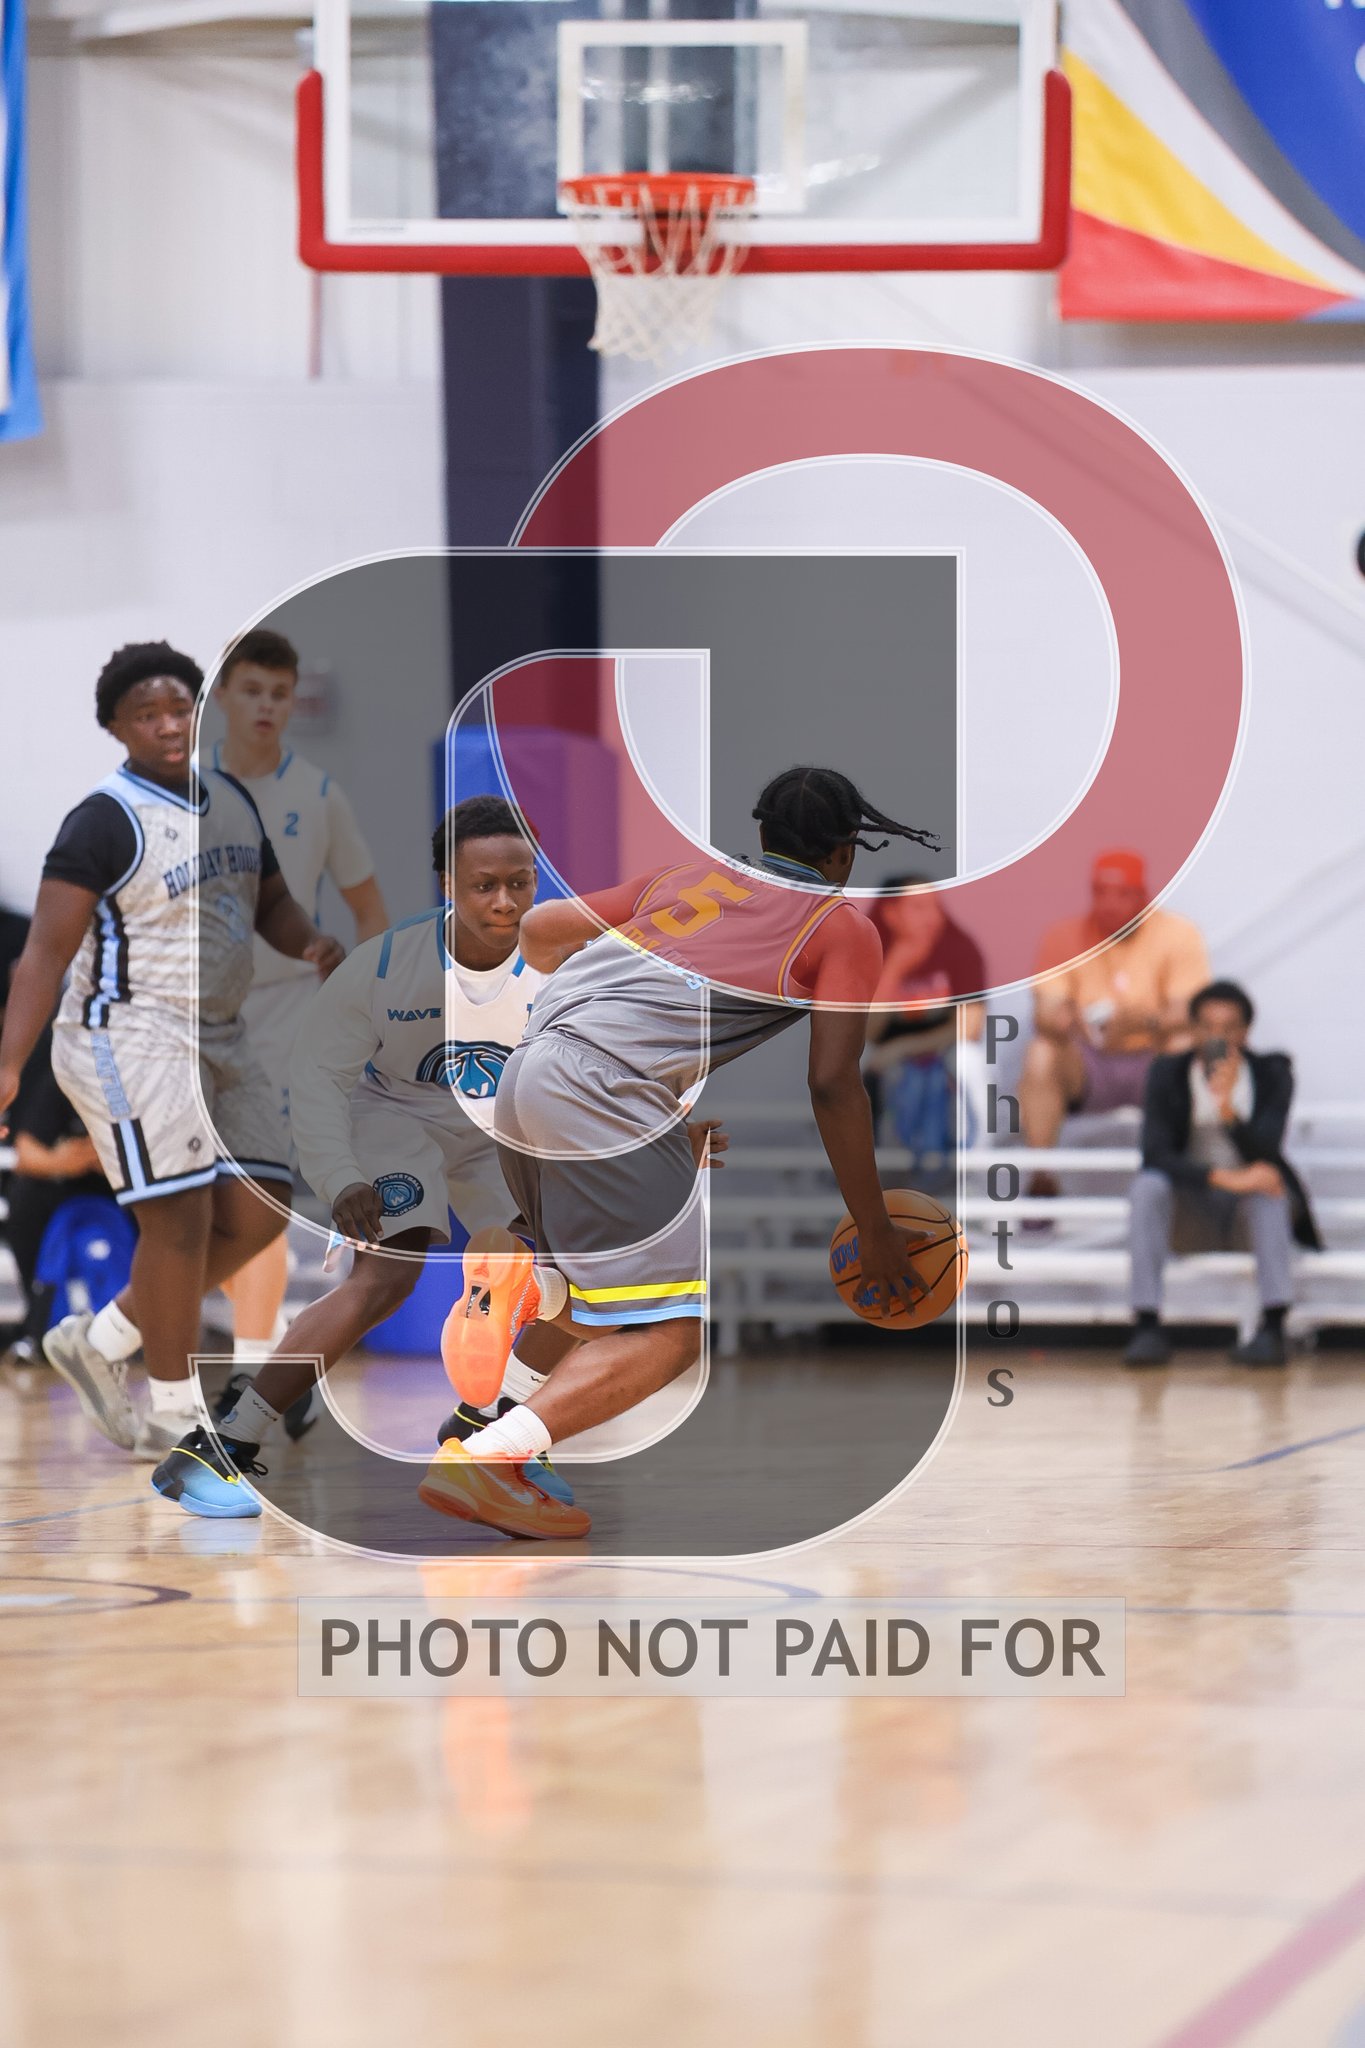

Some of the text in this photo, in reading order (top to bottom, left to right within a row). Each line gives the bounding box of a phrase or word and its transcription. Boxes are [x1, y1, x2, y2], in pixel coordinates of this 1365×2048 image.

[284, 813, 299, 837] 2
[651, 871, 756, 939] 5
[387, 1007, 442, 1022] WAVE
